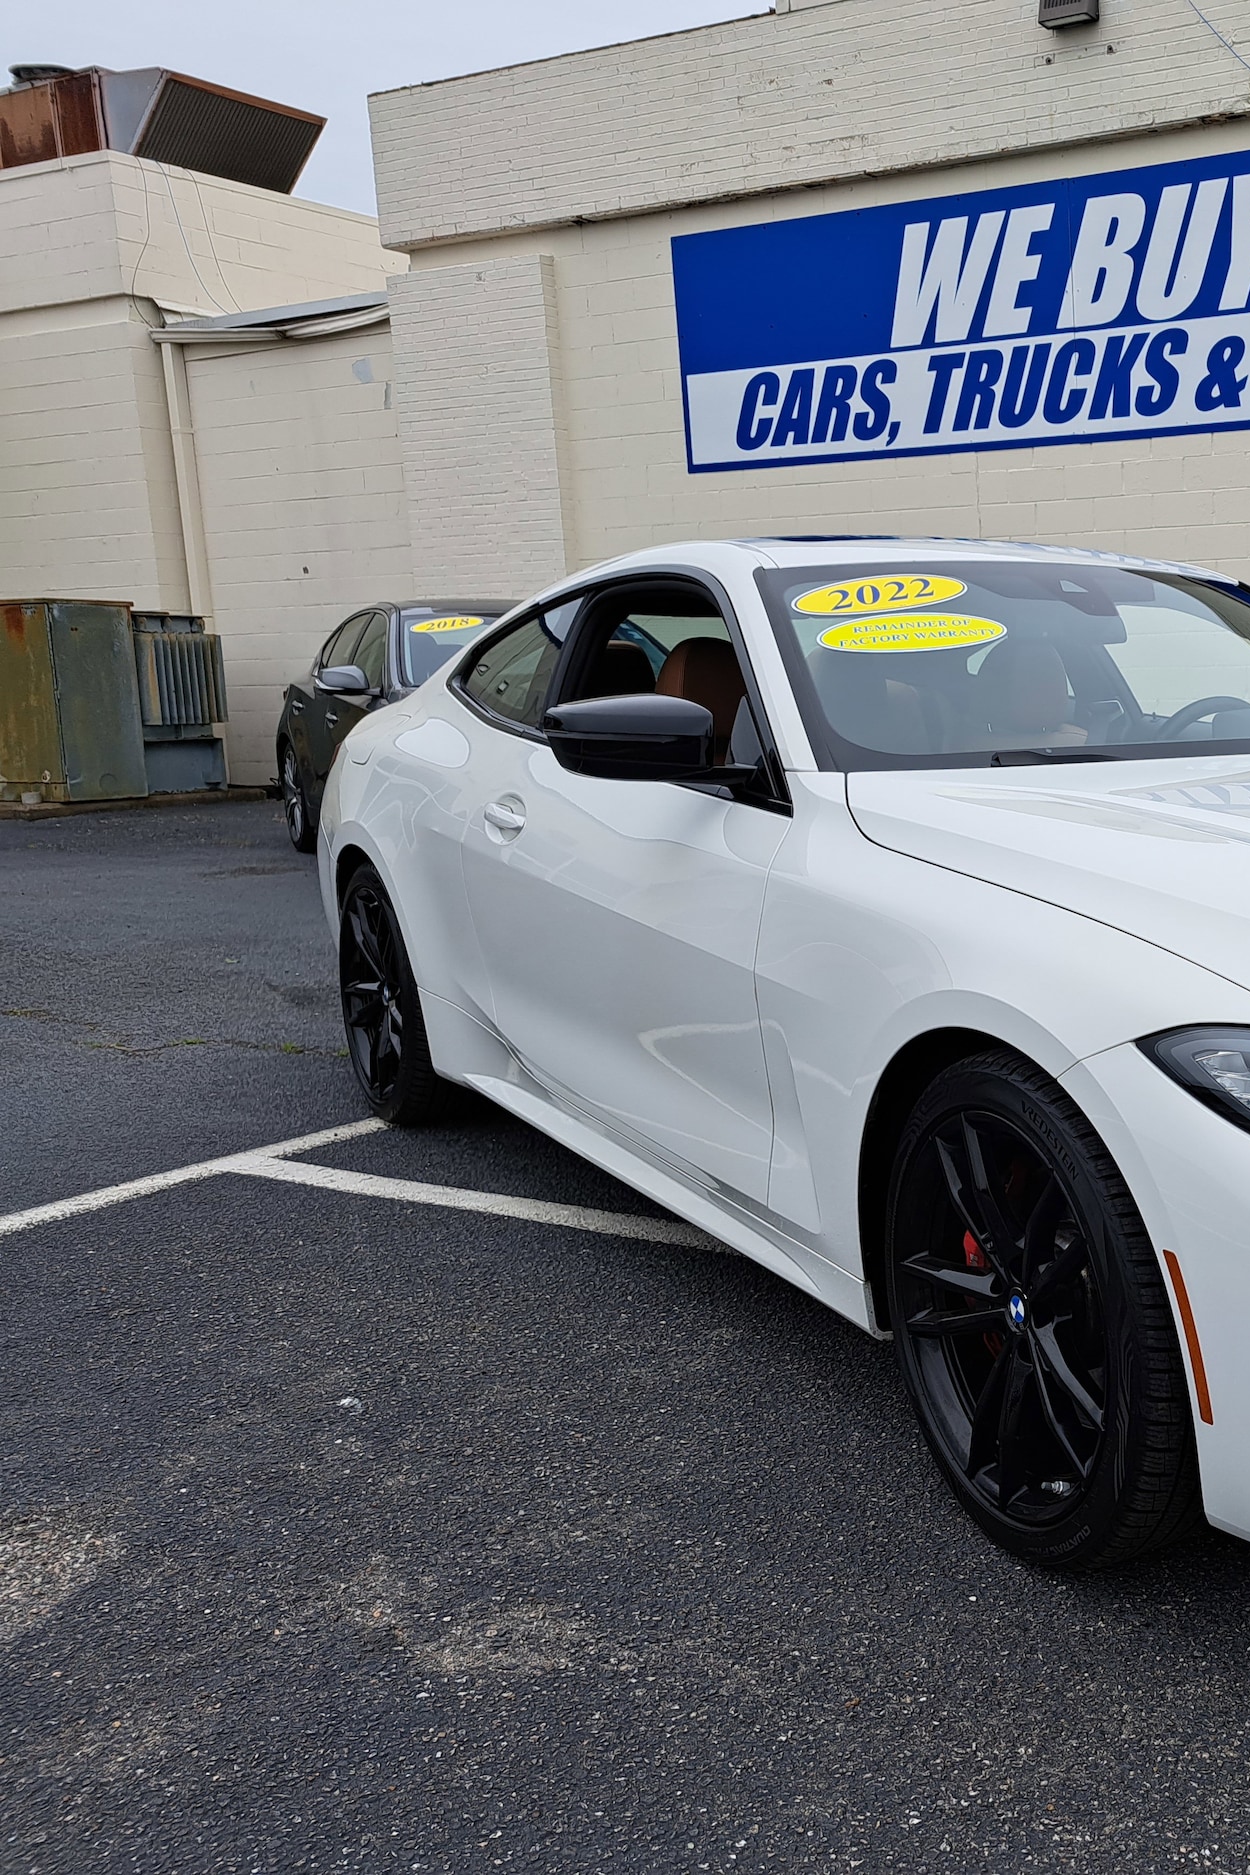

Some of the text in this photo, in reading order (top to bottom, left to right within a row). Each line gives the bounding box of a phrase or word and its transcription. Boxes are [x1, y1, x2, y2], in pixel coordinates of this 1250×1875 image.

[890, 203, 1055, 348] WE
[735, 358, 901, 451] CARS,
[922, 327, 1190, 435] TRUCKS
[1194, 335, 1249, 412] &
[828, 578, 934, 611] 2022
[425, 618, 470, 631] 2018
[839, 628, 997, 648] FACTORY WARRANTY
[853, 619, 972, 634] REMAINDER OF
[1021, 1101, 1080, 1180] VREDESTEIN
